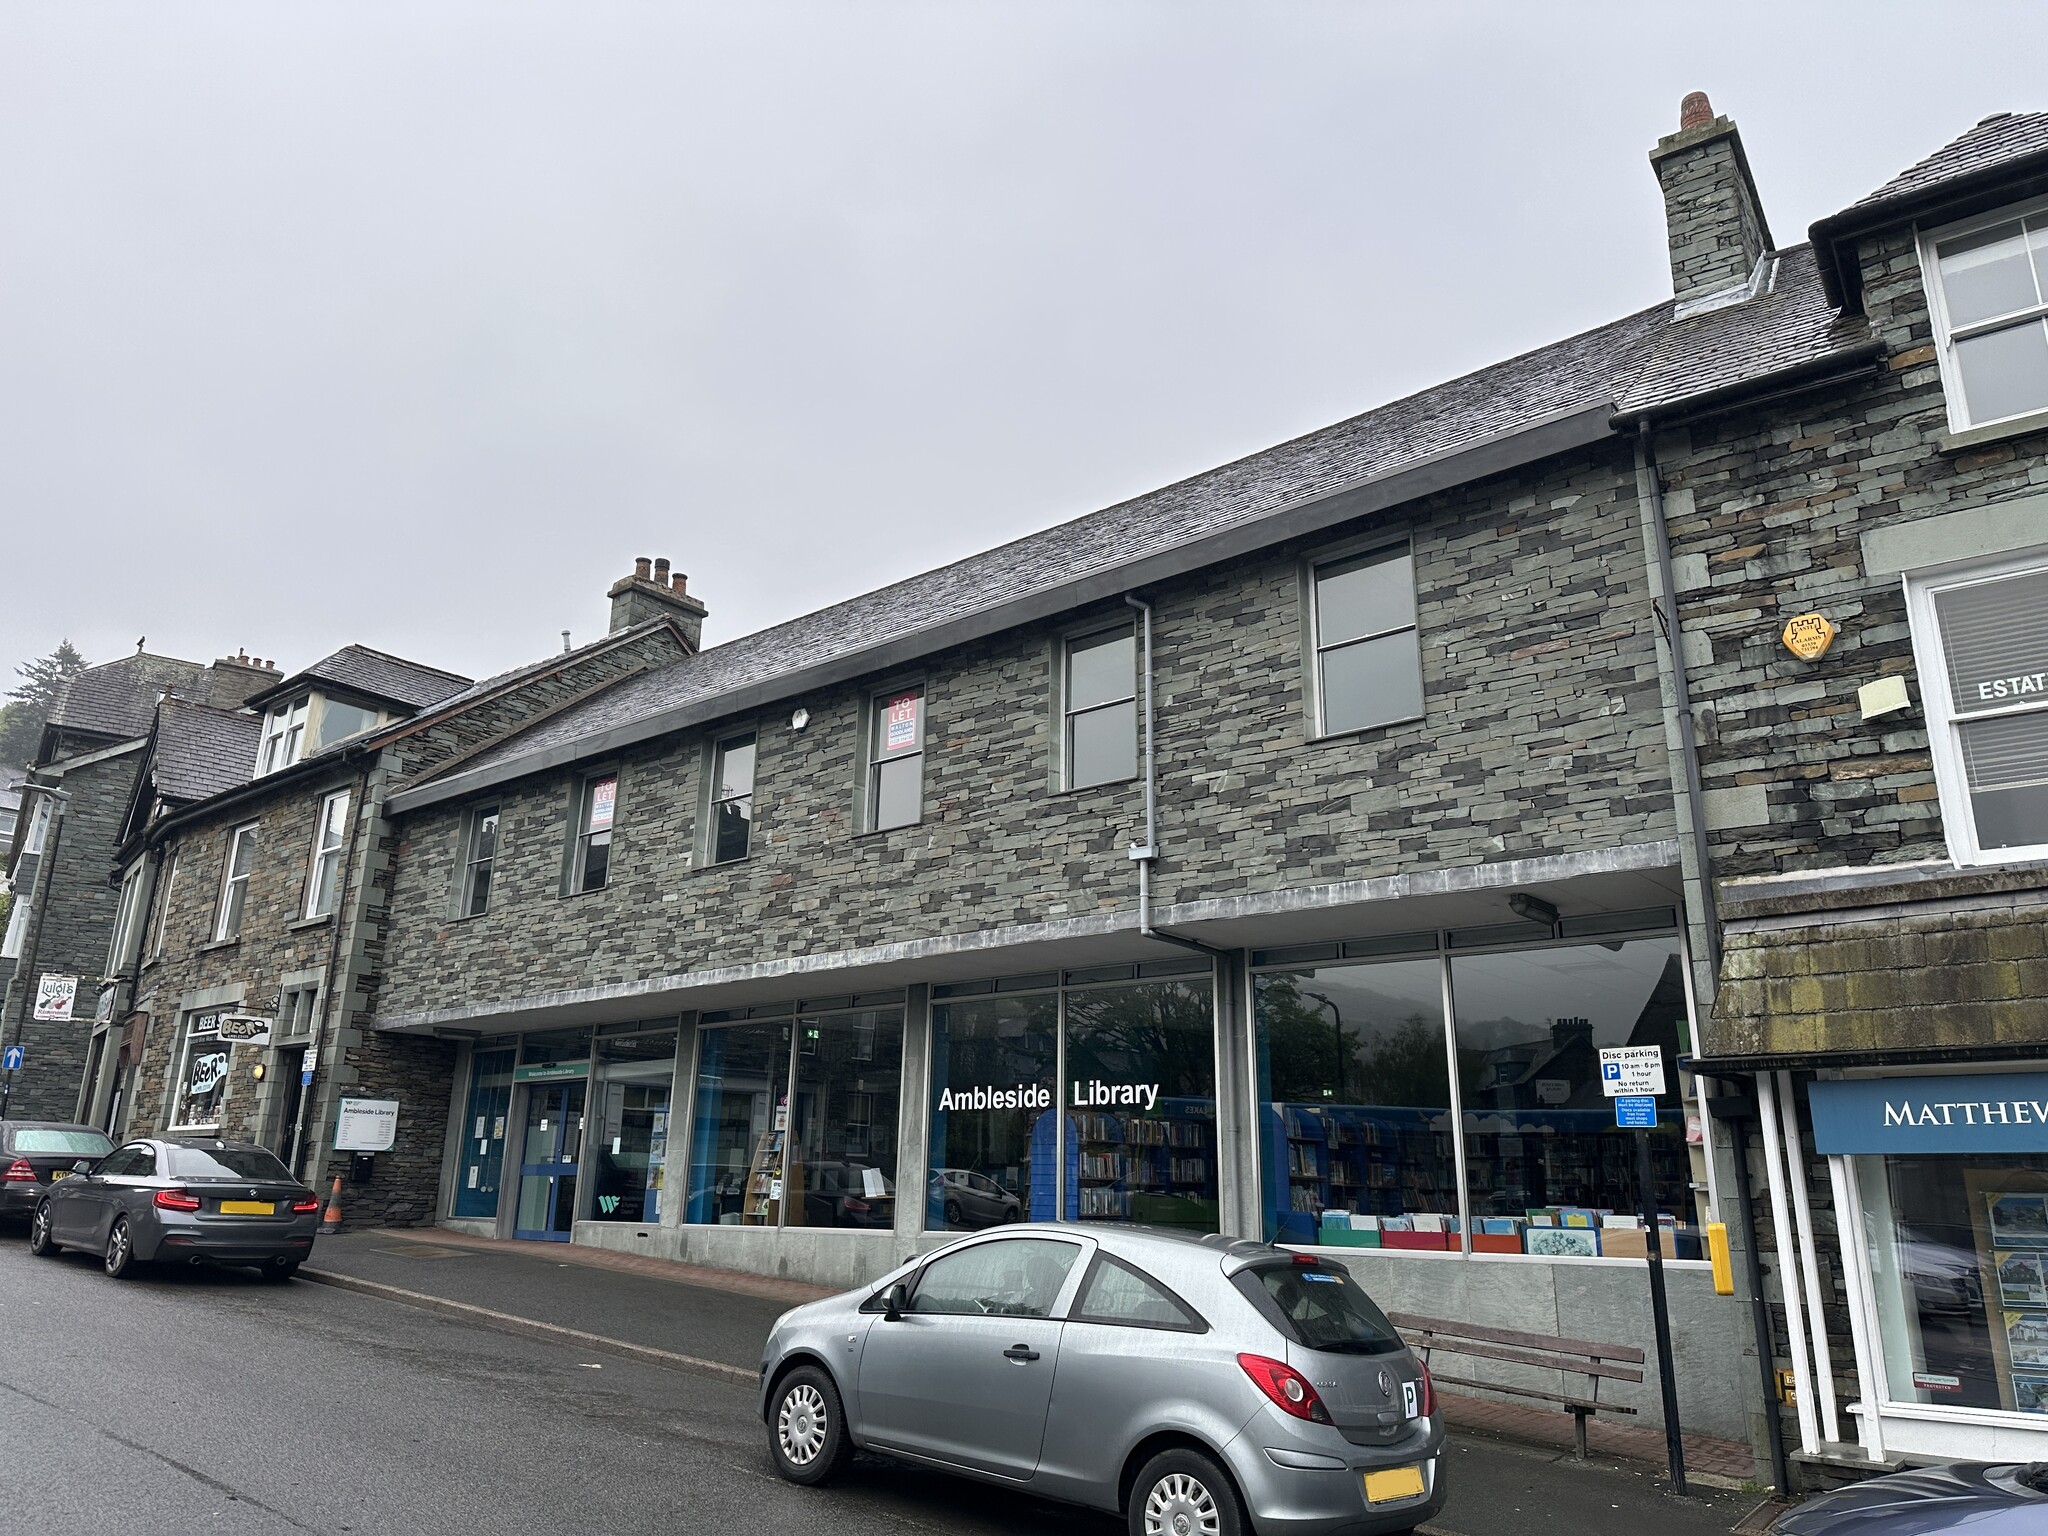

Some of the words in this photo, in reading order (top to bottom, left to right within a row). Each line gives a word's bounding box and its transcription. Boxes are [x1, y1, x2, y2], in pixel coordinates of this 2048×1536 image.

[1978, 672, 2048, 700] ESTAT
[894, 698, 910, 710] TO
[892, 708, 912, 722] LET
[600, 782, 612, 791] TO
[597, 791, 613, 801] LET
[198, 1015, 216, 1030] BEER
[1624, 1050, 1659, 1059] parking
[1607, 1065, 1618, 1078] P
[938, 1083, 1050, 1111] Ambleside
[1074, 1080, 1159, 1111] Library
[1405, 1386, 1414, 1414] P
